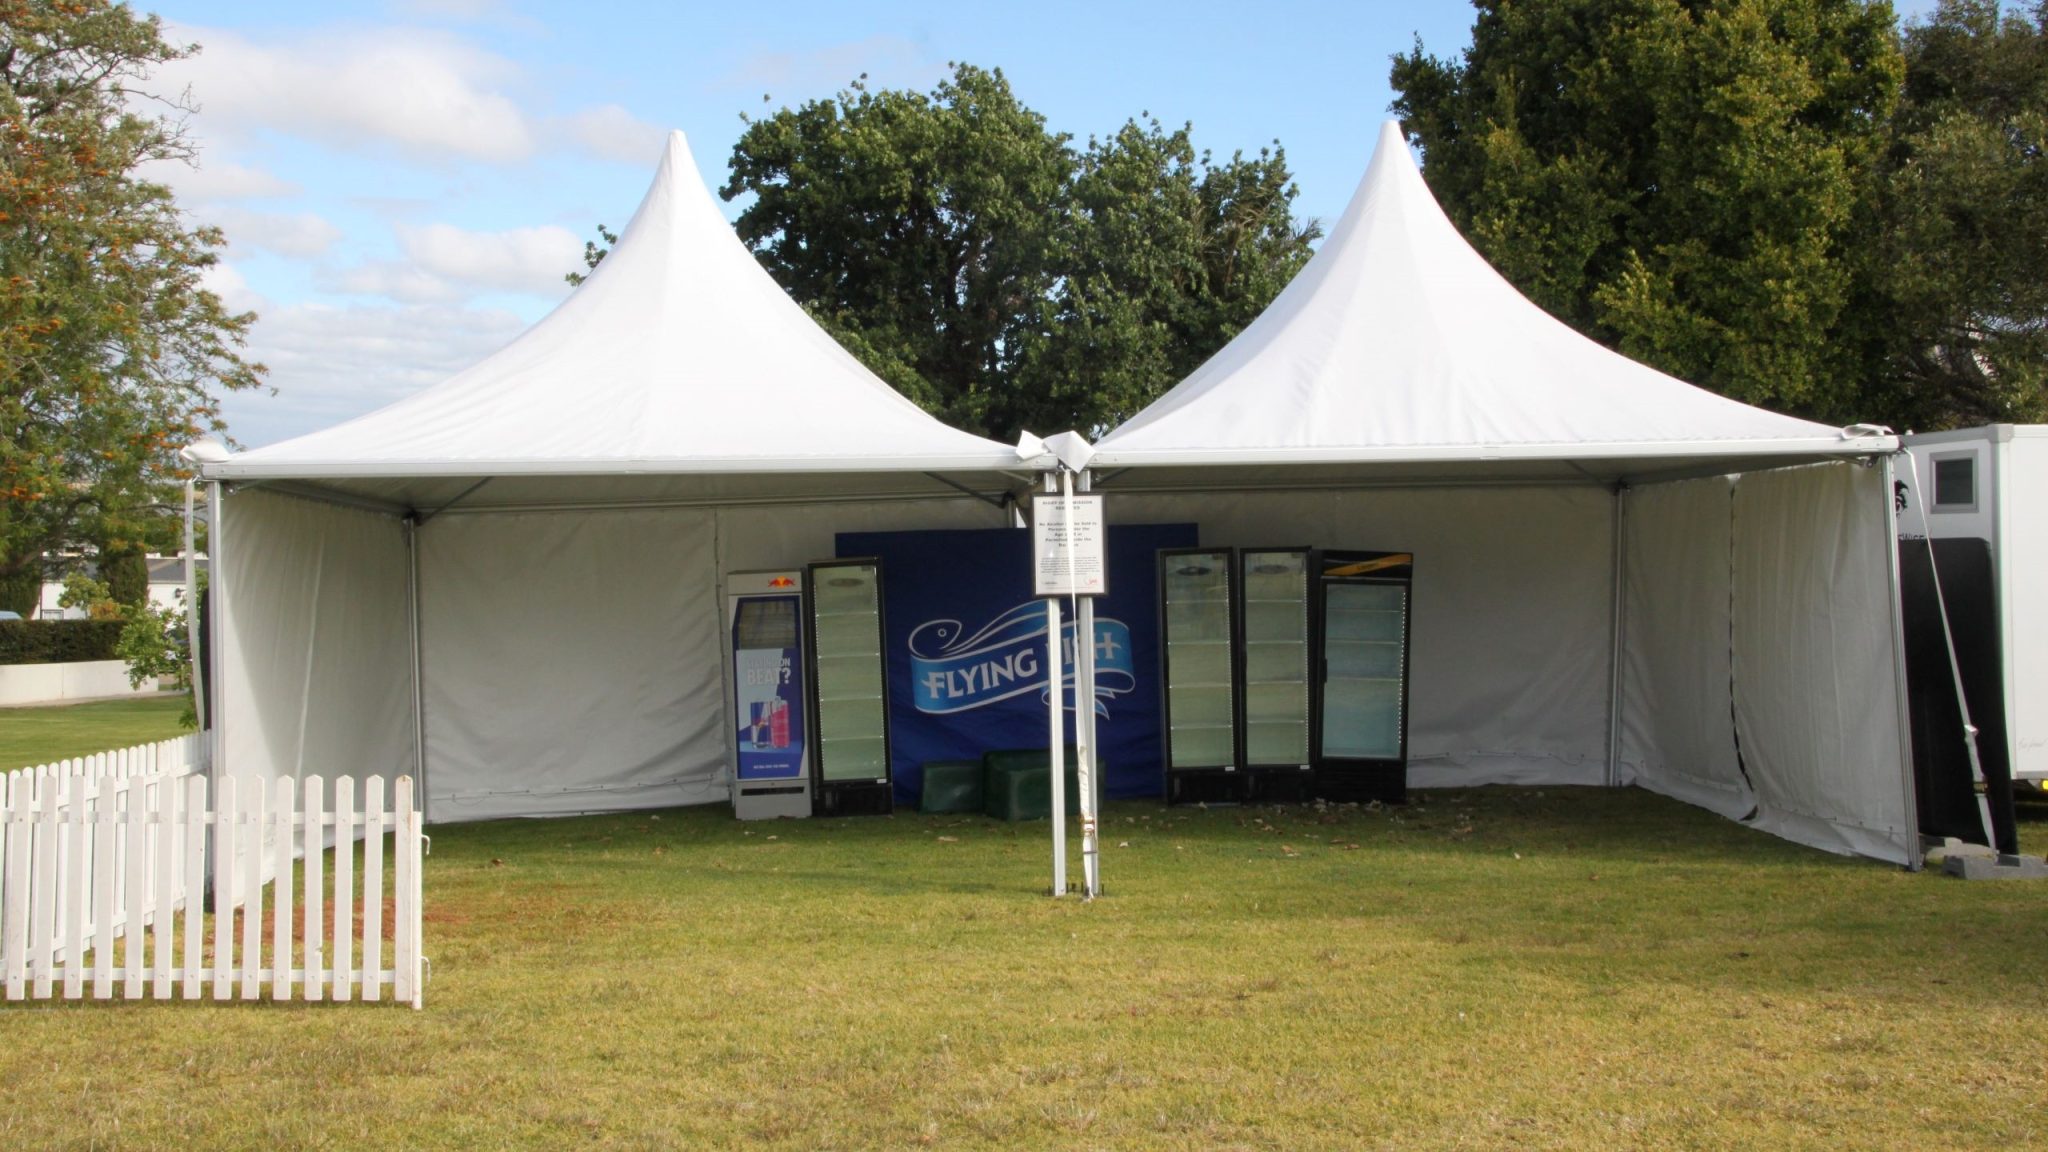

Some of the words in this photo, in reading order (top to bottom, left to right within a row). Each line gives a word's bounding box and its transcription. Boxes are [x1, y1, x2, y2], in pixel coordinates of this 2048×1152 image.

[748, 667, 791, 685] BEAT?
[922, 648, 1037, 698] FLYING
[1045, 632, 1121, 666] IH
